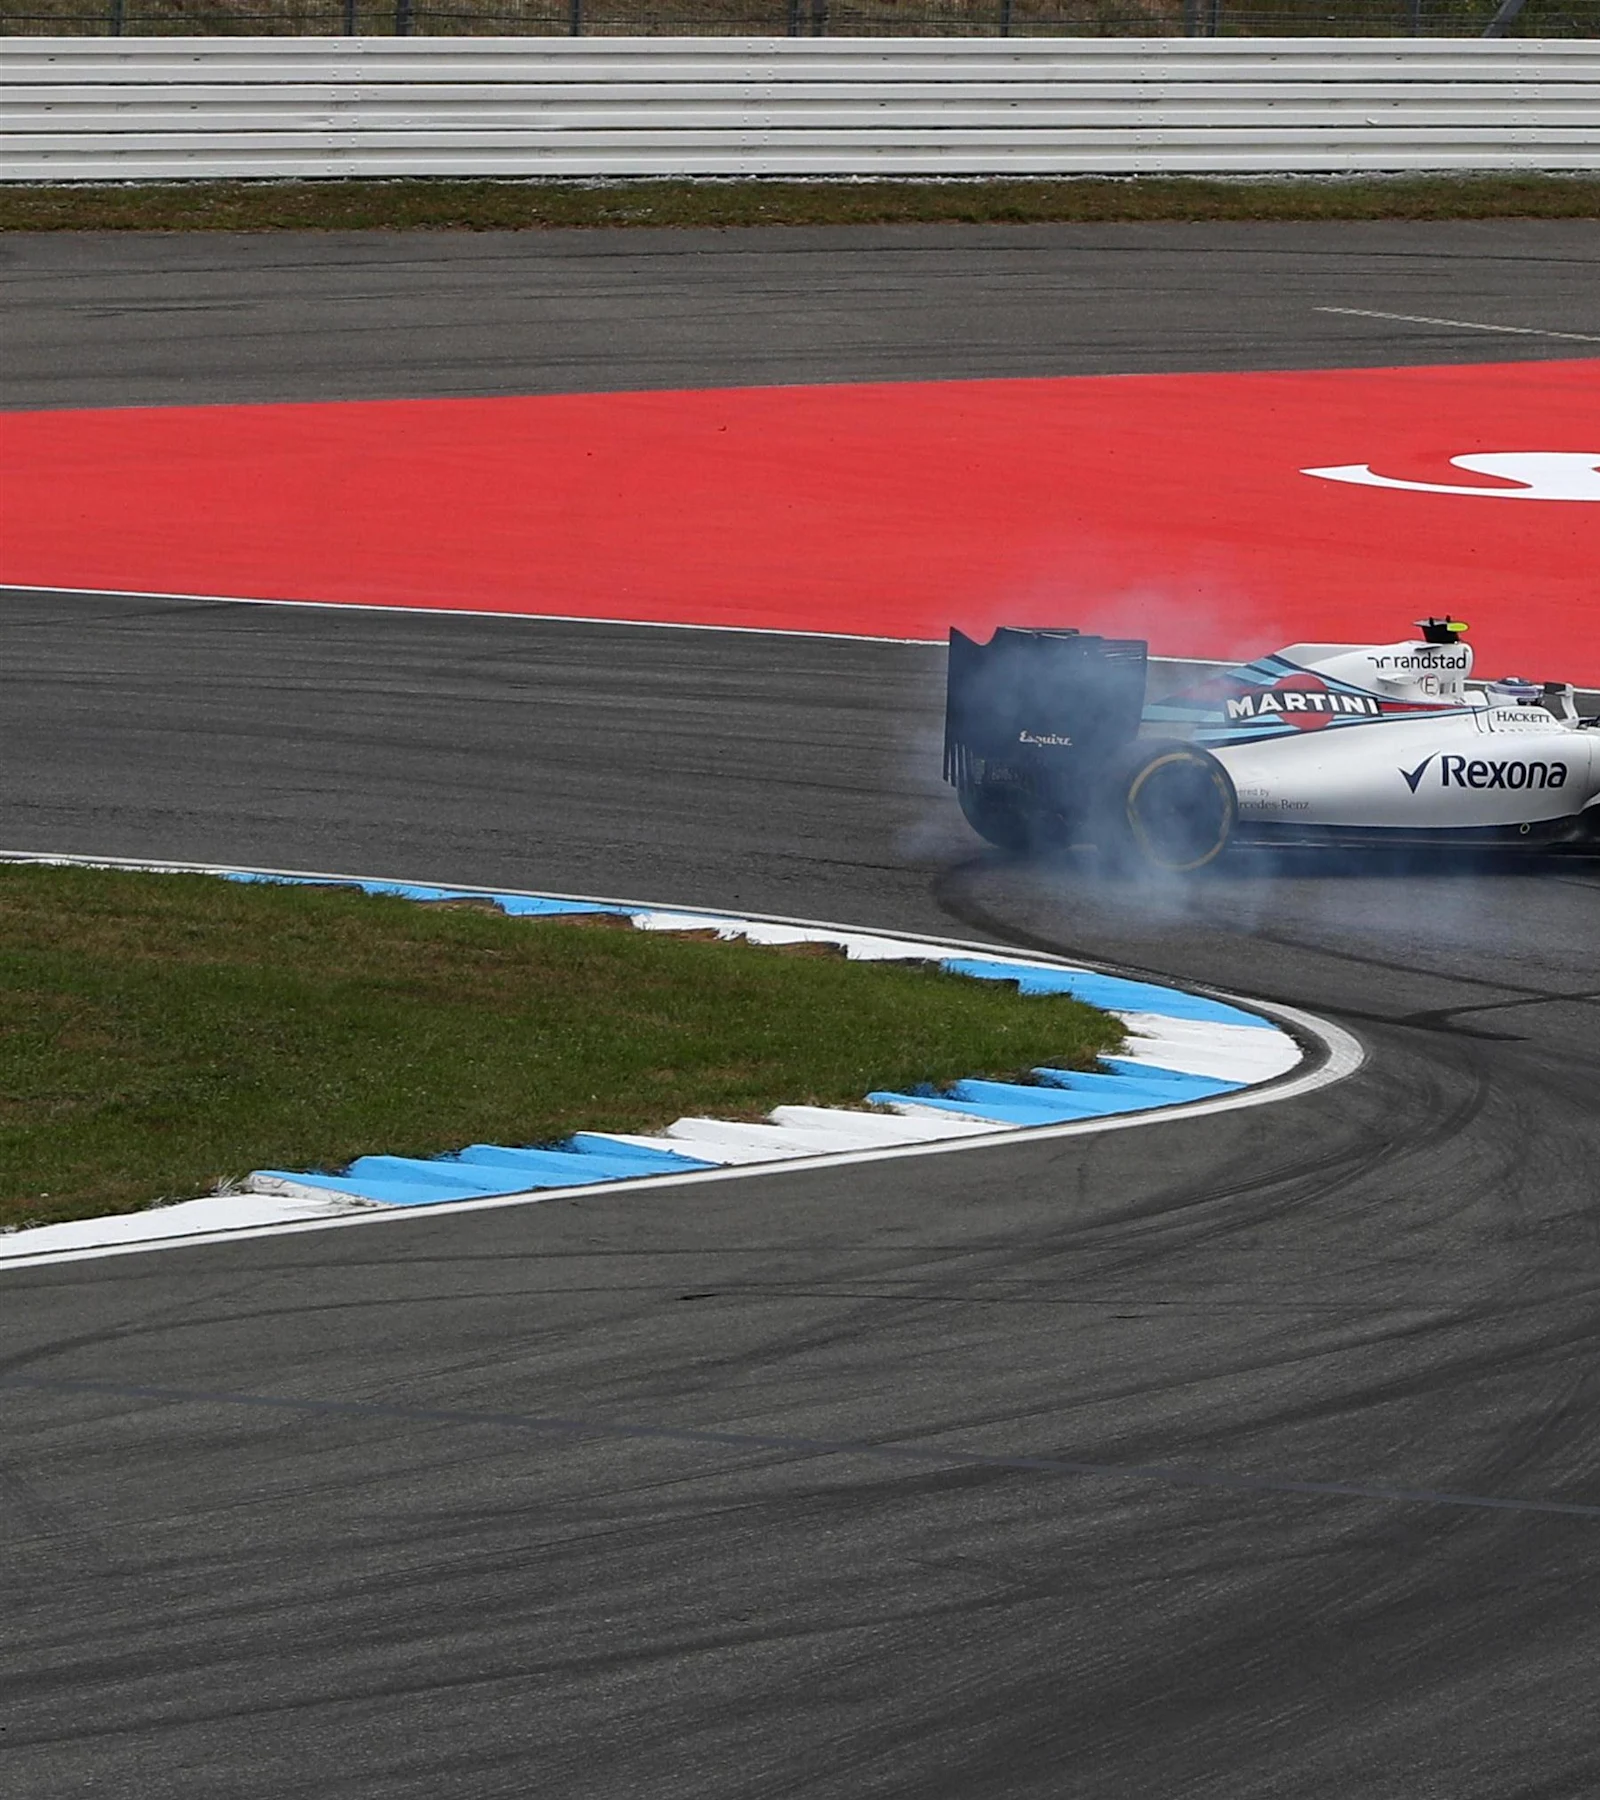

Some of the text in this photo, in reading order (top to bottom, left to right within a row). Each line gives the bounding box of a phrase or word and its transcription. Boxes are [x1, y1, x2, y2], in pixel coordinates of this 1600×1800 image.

[1393, 652, 1467, 669] randstad
[1227, 692, 1379, 719] MARTINI
[1497, 711, 1550, 723] HACKETT
[1019, 730, 1073, 747] Esquire
[1441, 755, 1567, 789] Rexona
[1239, 799, 1309, 810] rcedes-Benz
